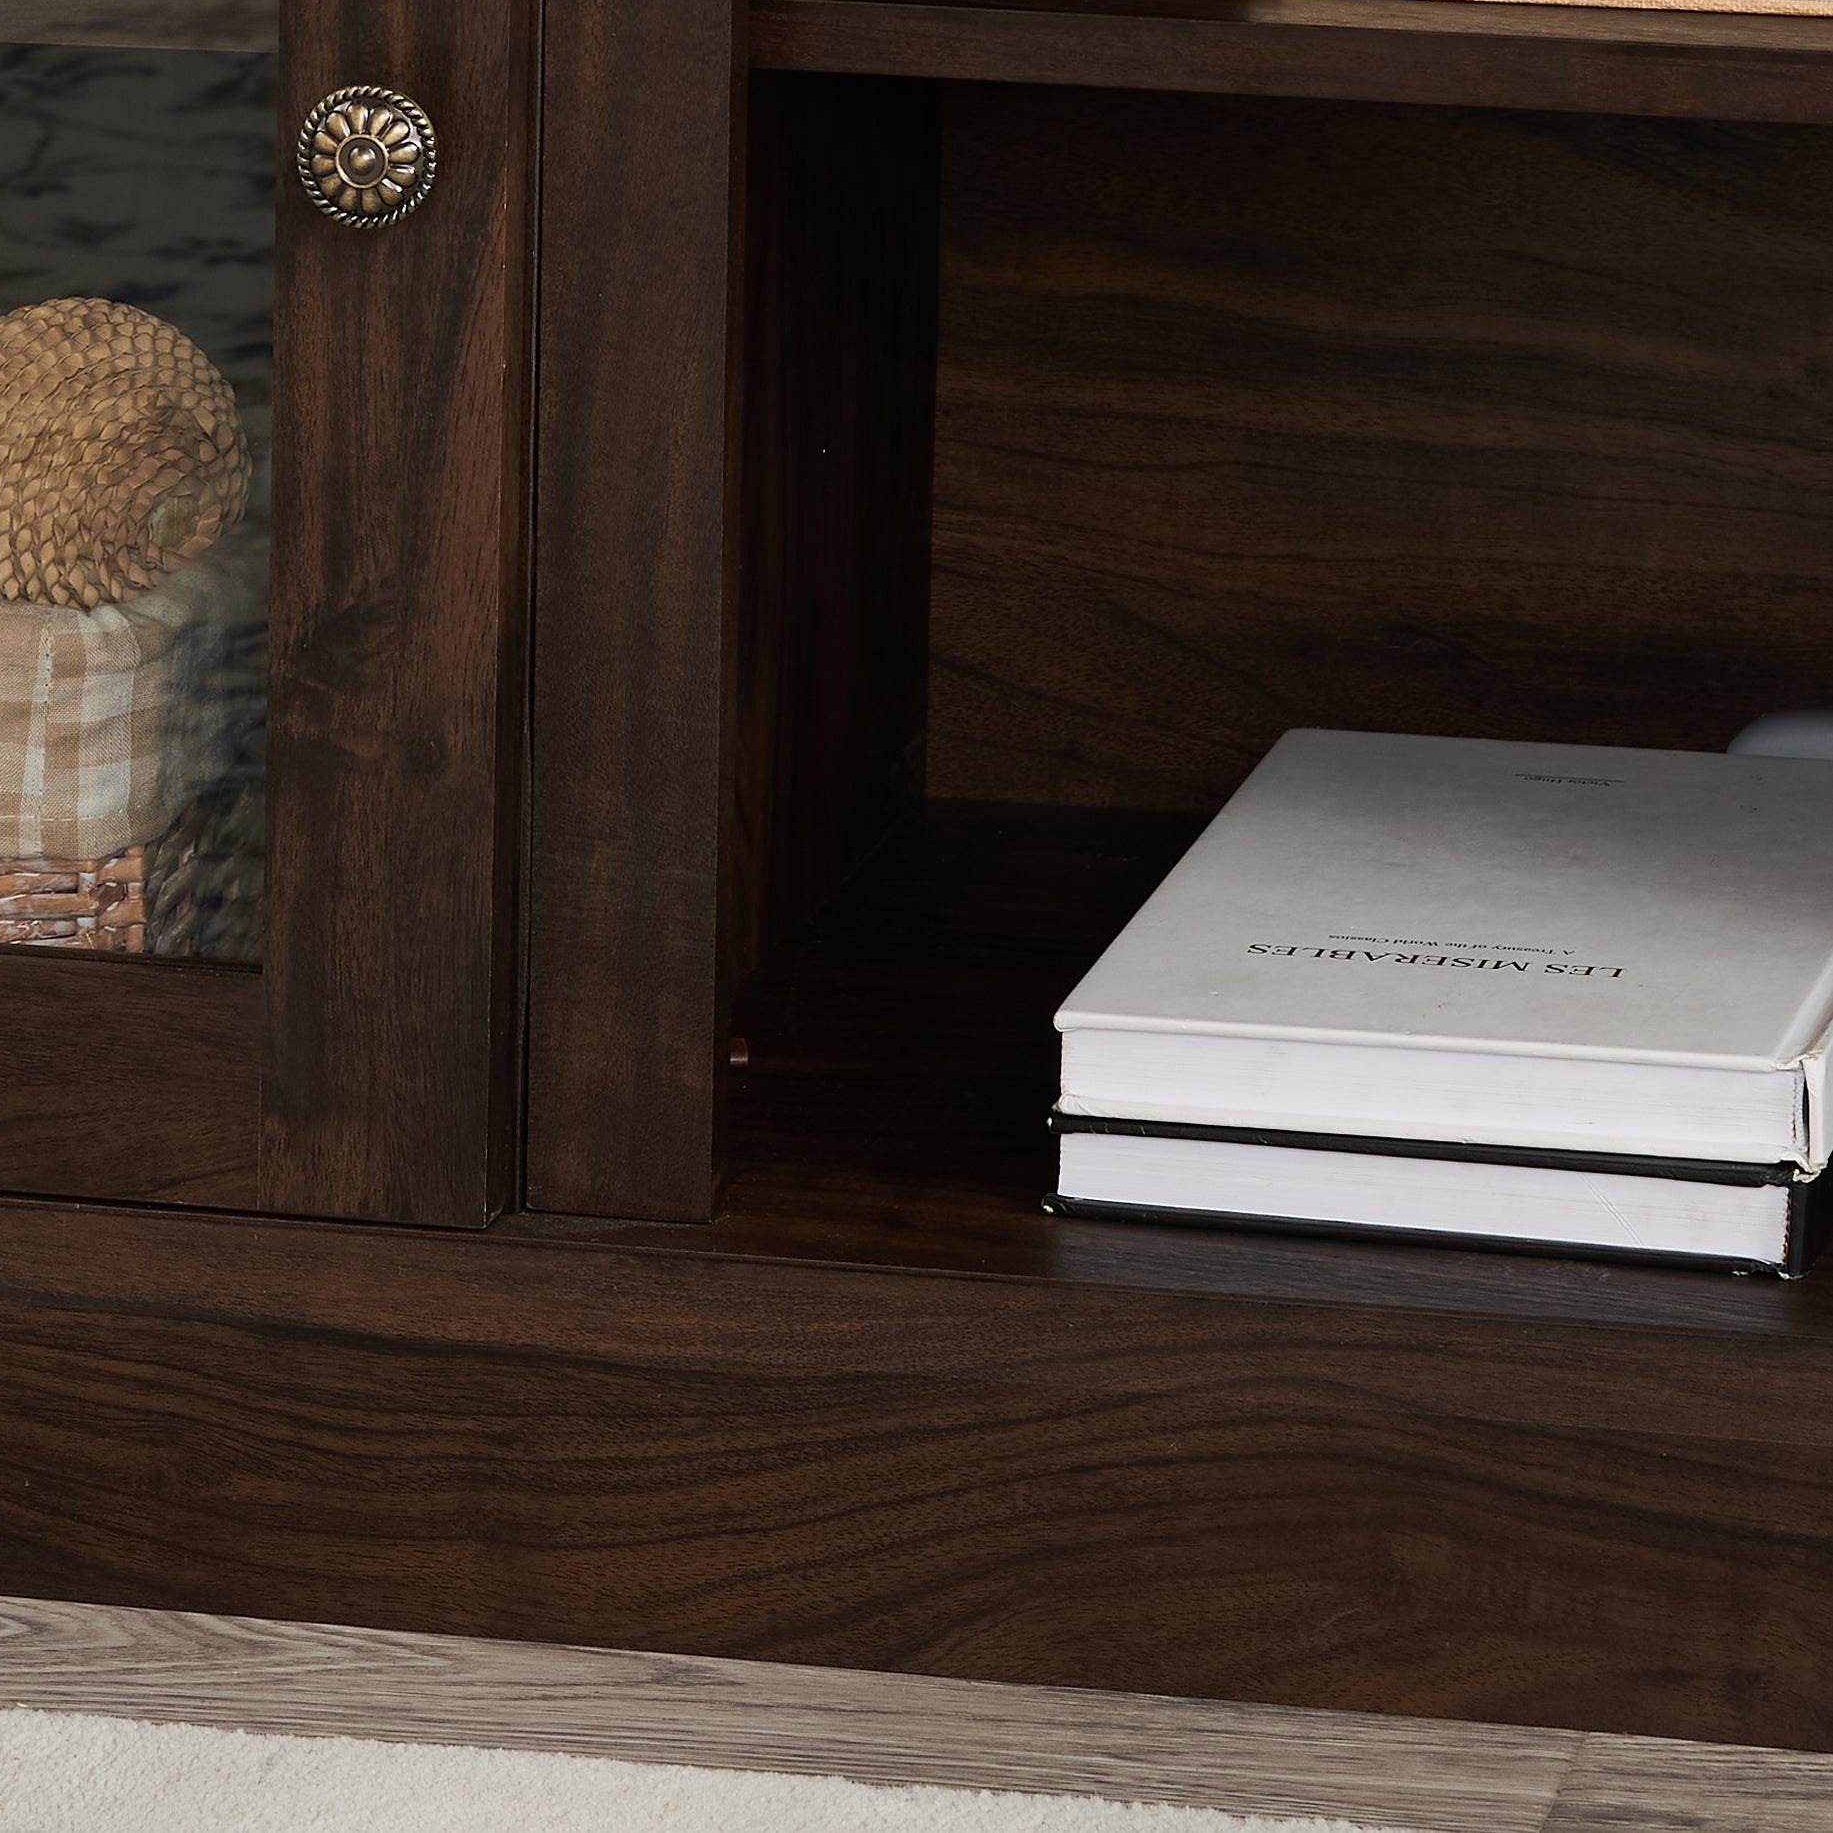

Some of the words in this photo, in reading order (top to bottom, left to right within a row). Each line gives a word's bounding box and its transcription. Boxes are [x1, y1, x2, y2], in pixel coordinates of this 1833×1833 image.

[1393, 938, 1439, 947] World
[1491, 944, 1556, 955] Treasury
[1247, 941, 1529, 972] MISERABLES
[1544, 963, 1627, 978] LES
